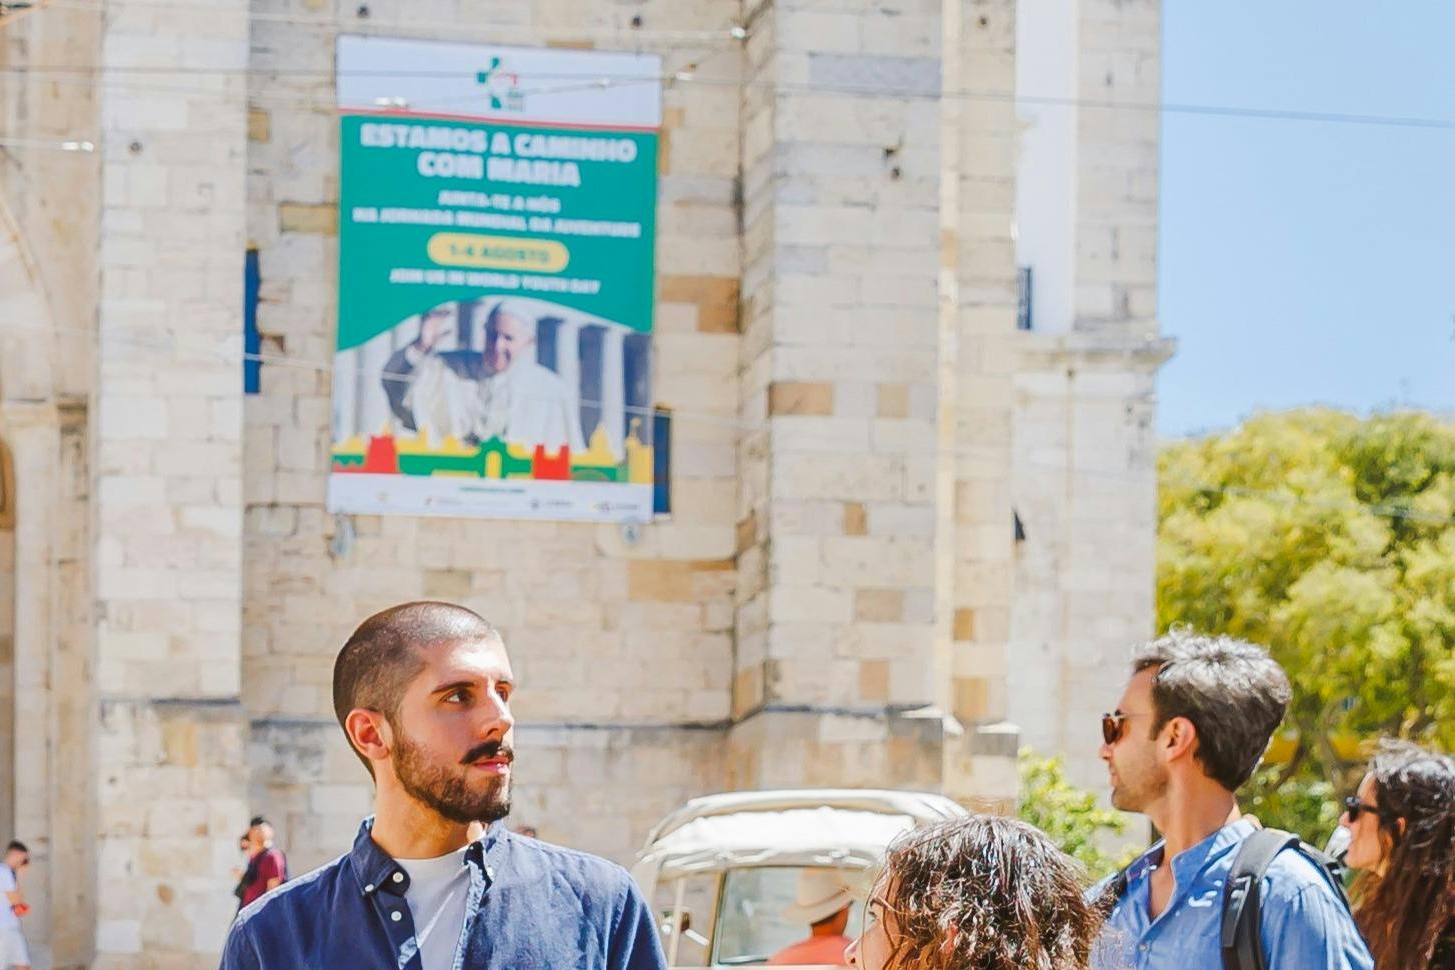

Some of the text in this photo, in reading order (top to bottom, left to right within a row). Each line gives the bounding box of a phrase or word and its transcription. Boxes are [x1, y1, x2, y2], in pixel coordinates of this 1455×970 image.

[360, 123, 638, 163] ESTAMOS A CAMINHO
[417, 151, 581, 187] COM MARIA
